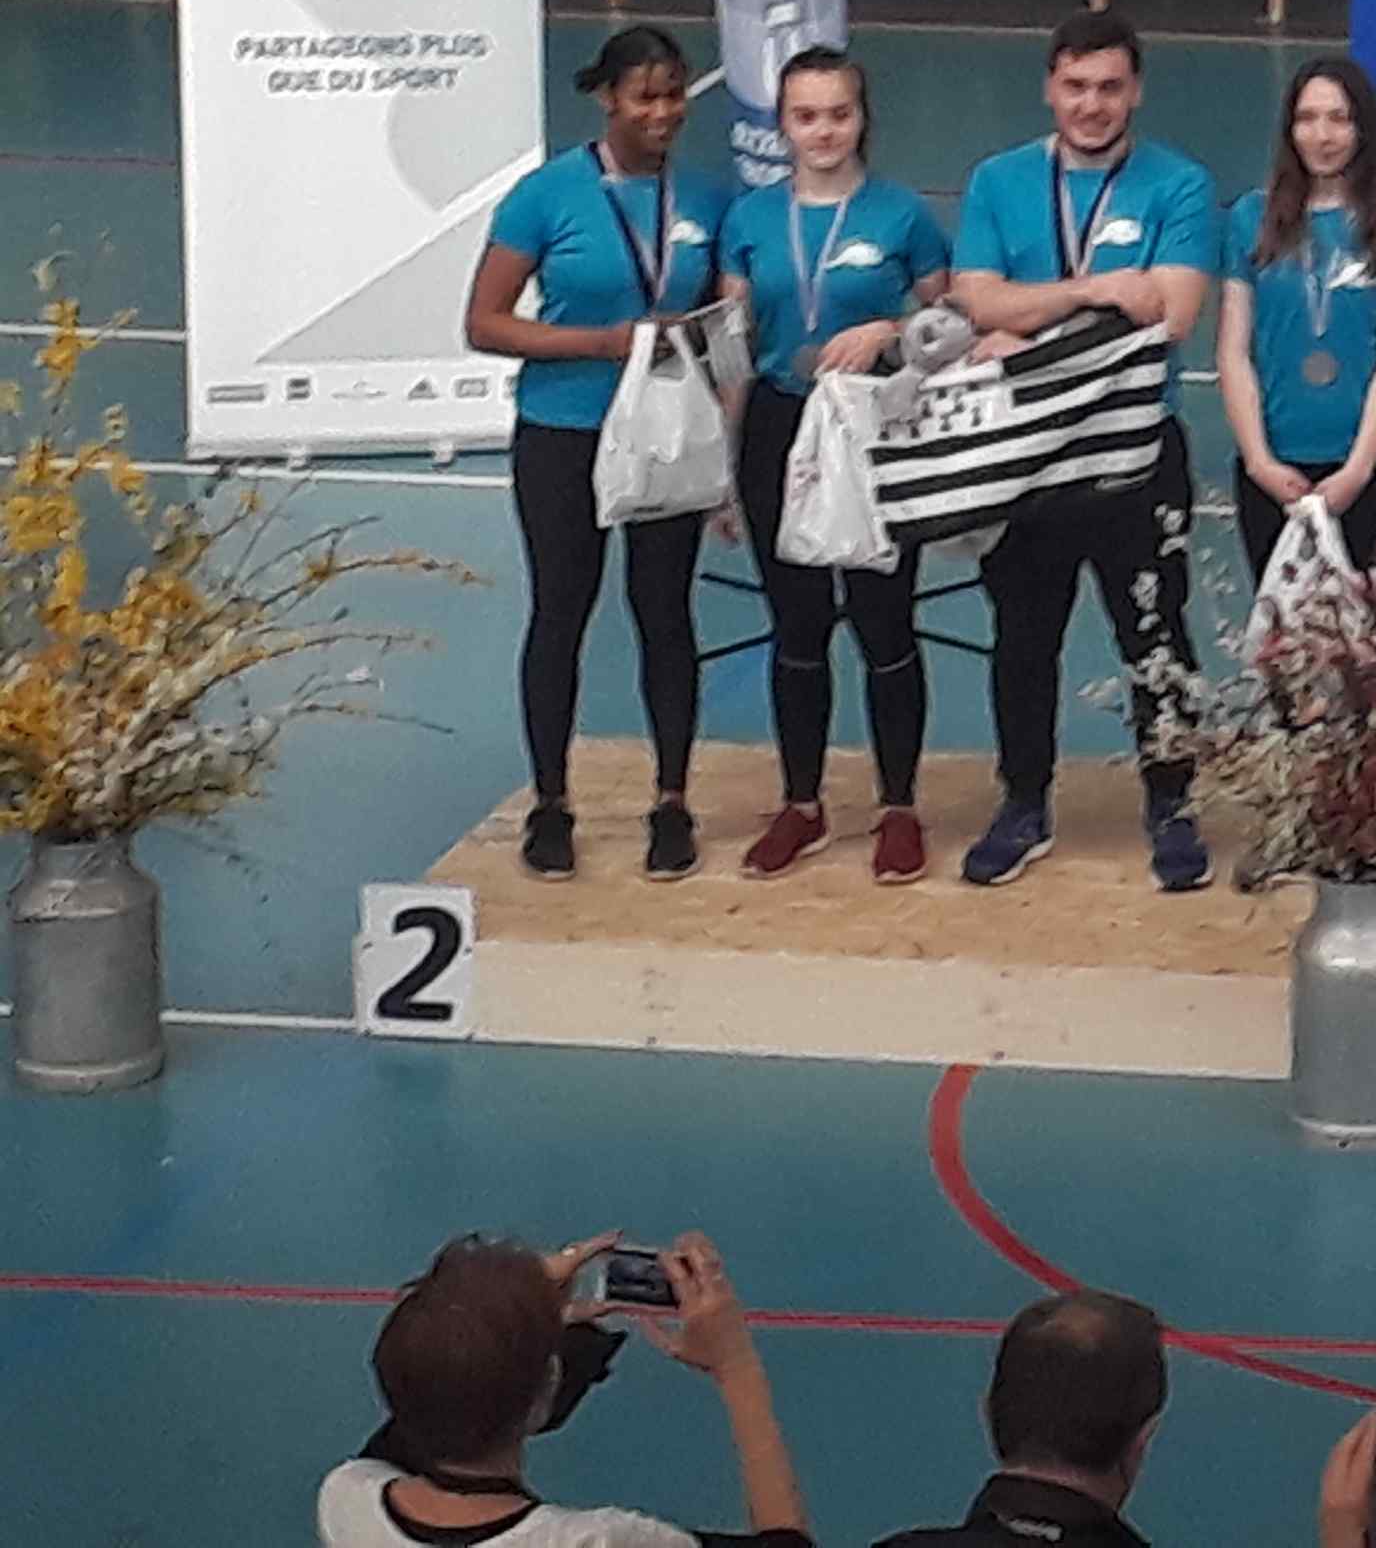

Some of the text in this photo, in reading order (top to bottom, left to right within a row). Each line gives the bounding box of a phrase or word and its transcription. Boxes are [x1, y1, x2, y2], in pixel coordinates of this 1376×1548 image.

[234, 35, 488, 57] PARTAGEONS PLUS
[268, 67, 459, 92] QUE DU SPORT
[377, 906, 462, 1021] 2
